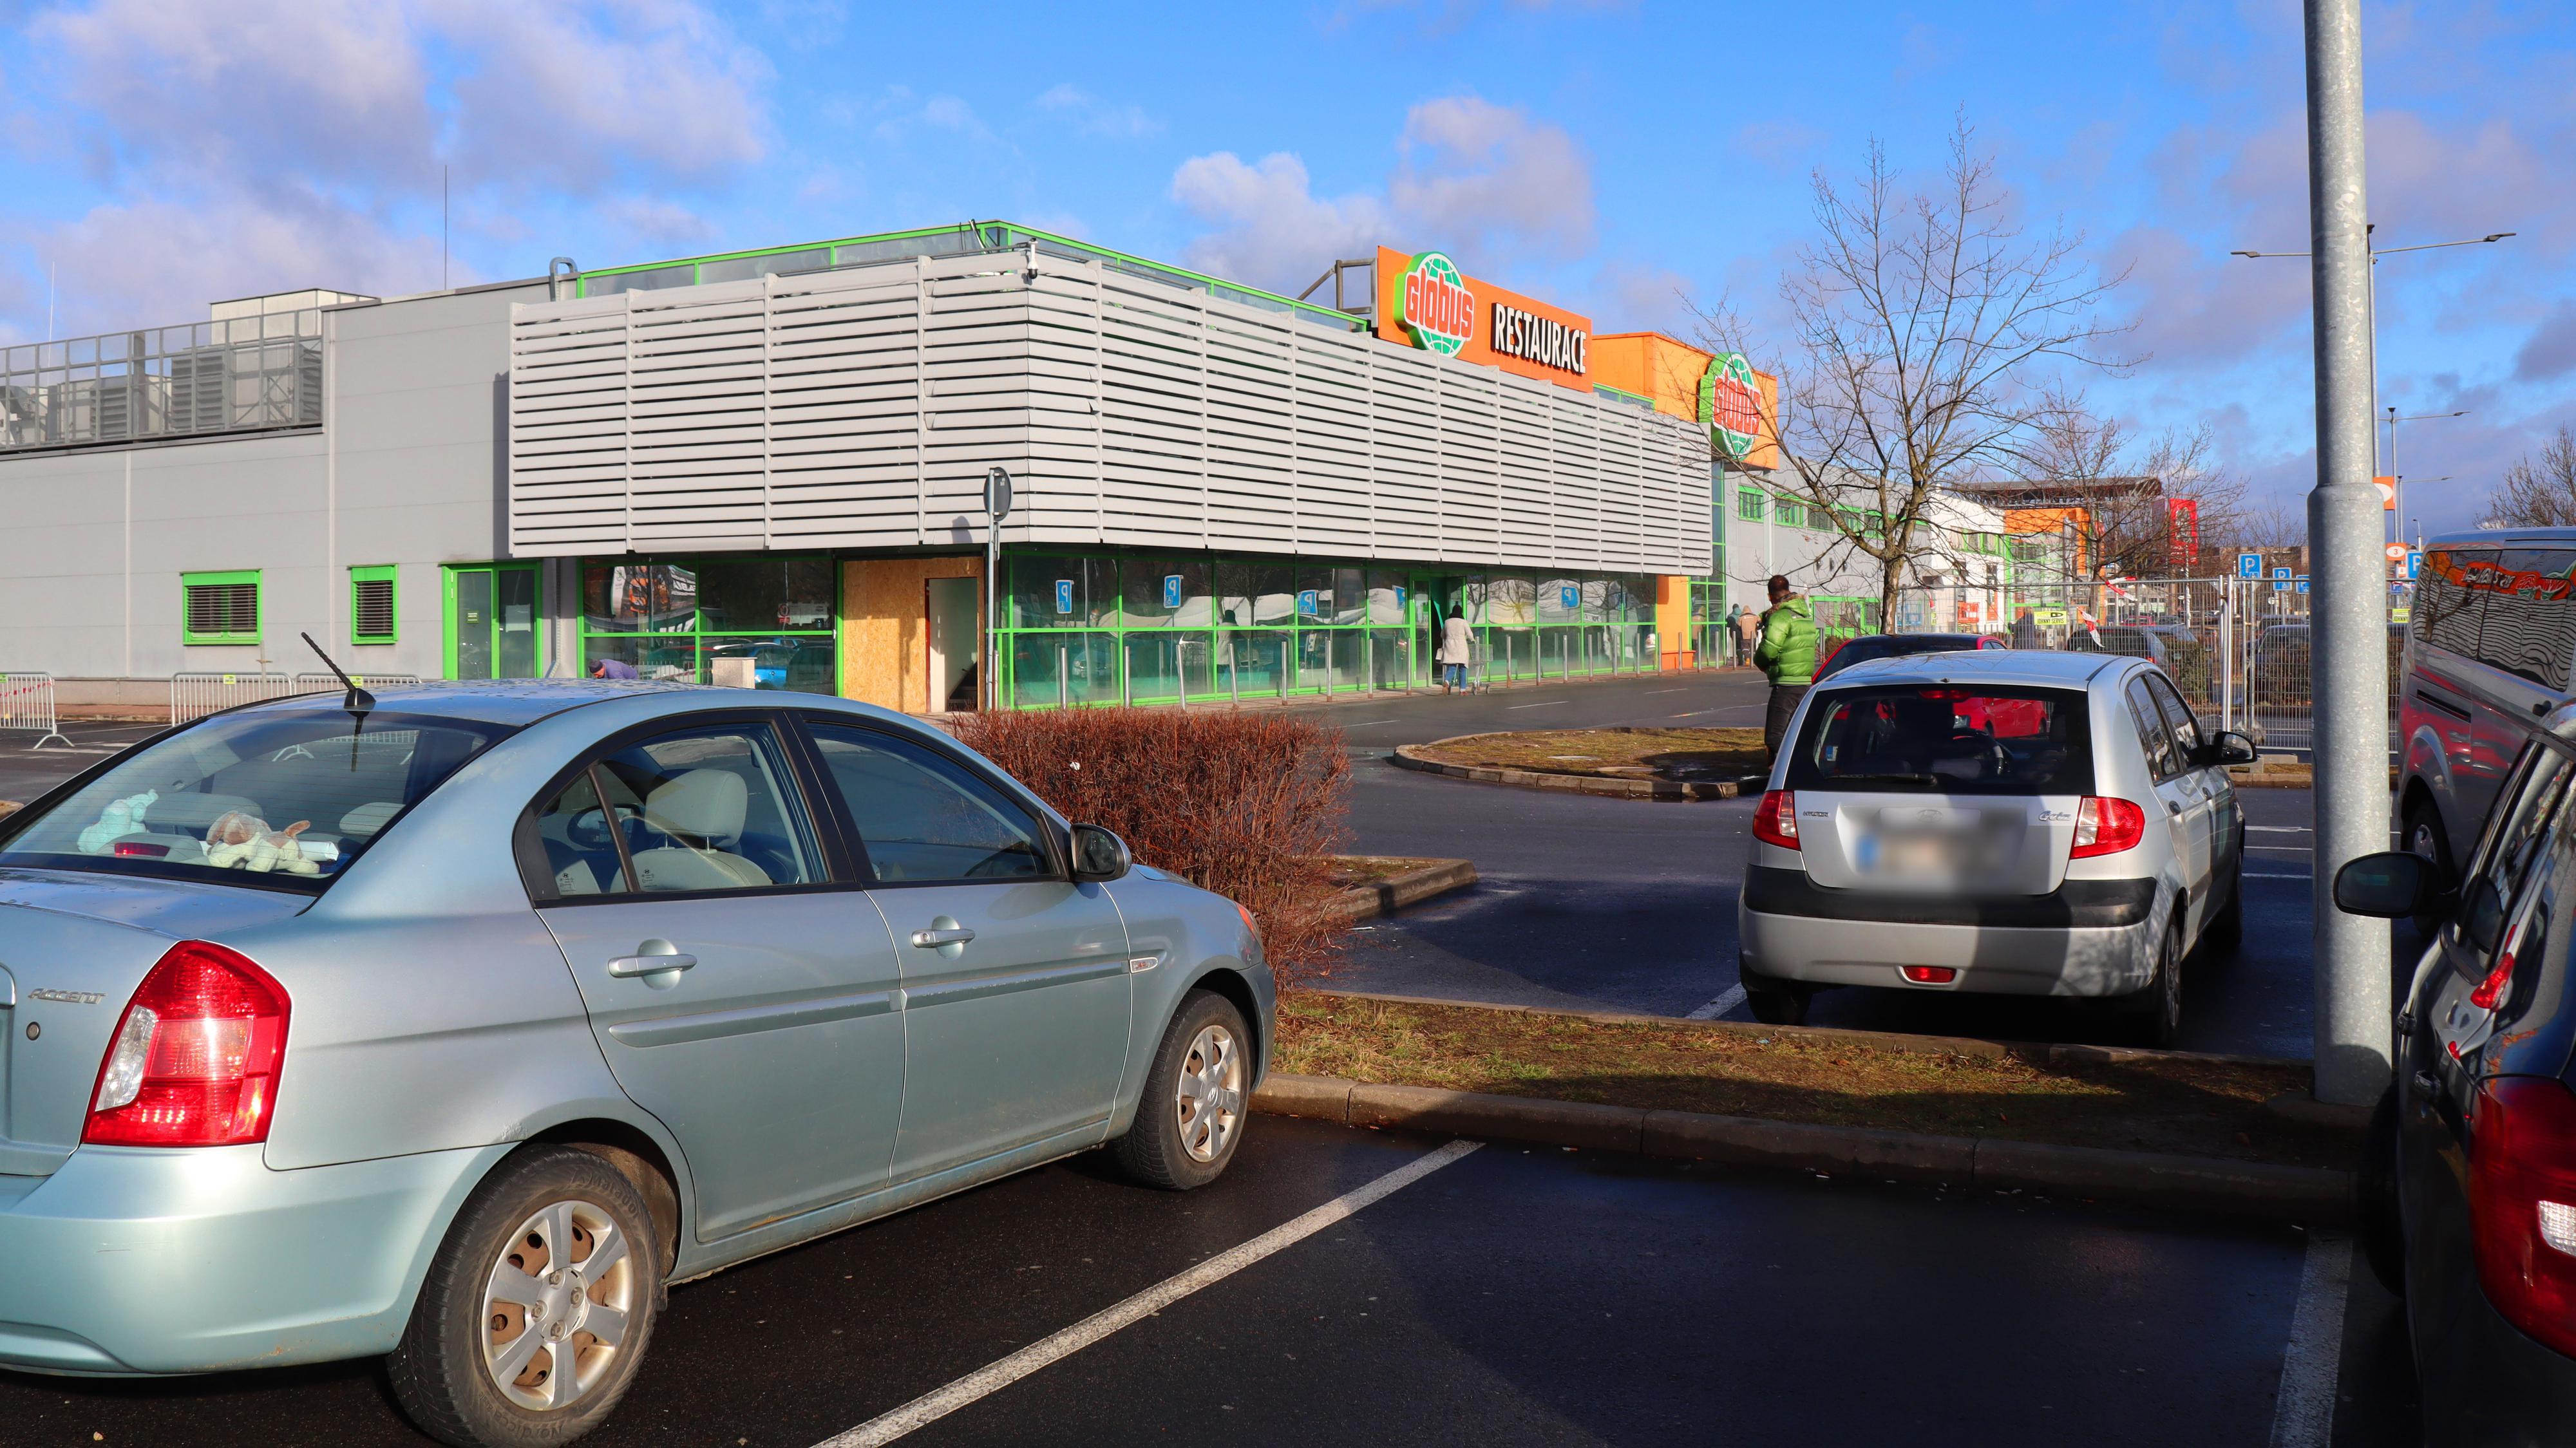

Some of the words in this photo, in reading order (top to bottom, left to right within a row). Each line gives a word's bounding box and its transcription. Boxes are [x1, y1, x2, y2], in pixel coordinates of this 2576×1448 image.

[1493, 302, 1587, 373] RESTAURACE
[2245, 557, 2255, 574] P
[2412, 554, 2422, 572] P
